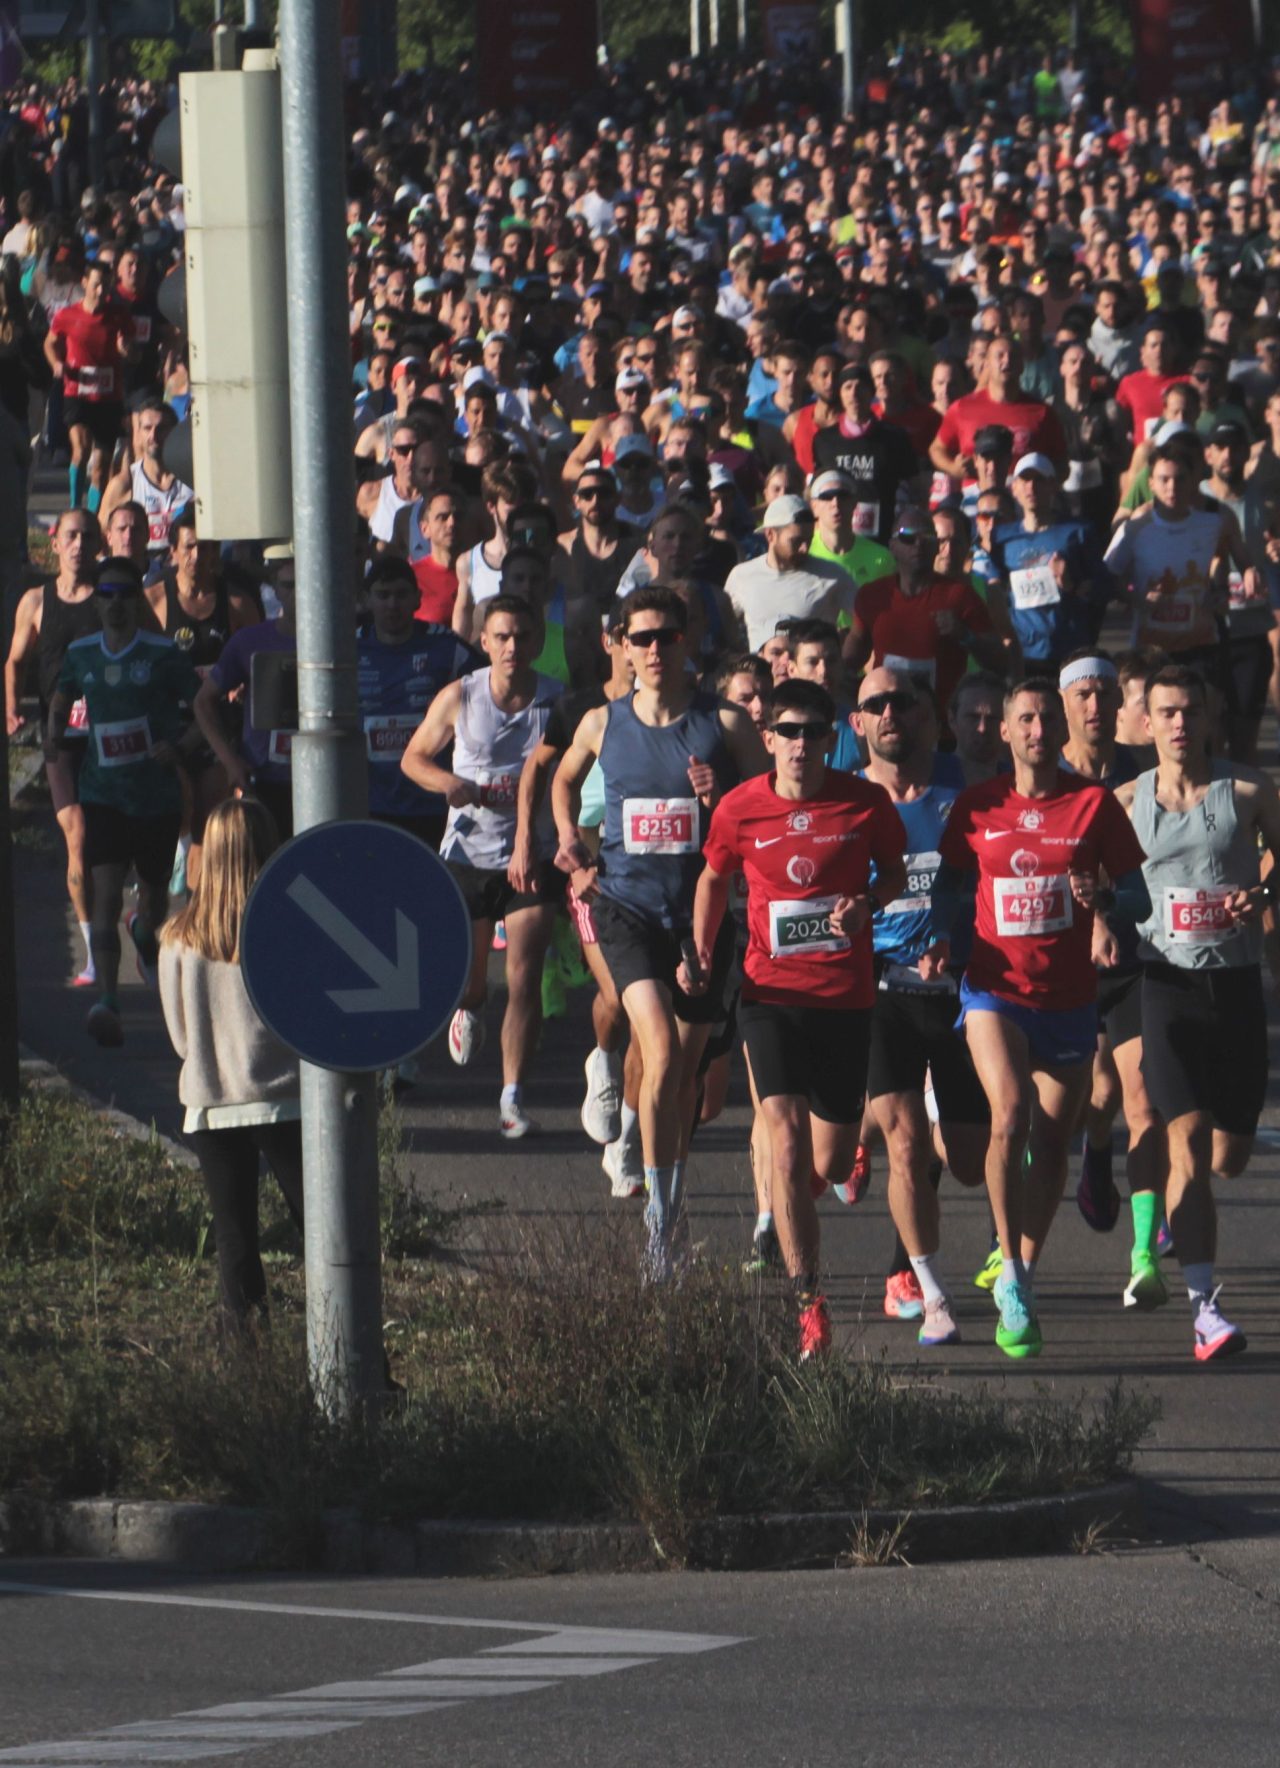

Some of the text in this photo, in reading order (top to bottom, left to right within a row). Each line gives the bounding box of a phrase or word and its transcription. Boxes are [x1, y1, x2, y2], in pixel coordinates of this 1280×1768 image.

[835, 454, 875, 470] TEAM
[376, 731, 409, 747] 899
[487, 787, 515, 802] 665
[638, 818, 682, 837] 8251
[1009, 896, 1056, 917] 4297
[1179, 907, 1226, 925] 6549
[785, 918, 831, 940] 2020
